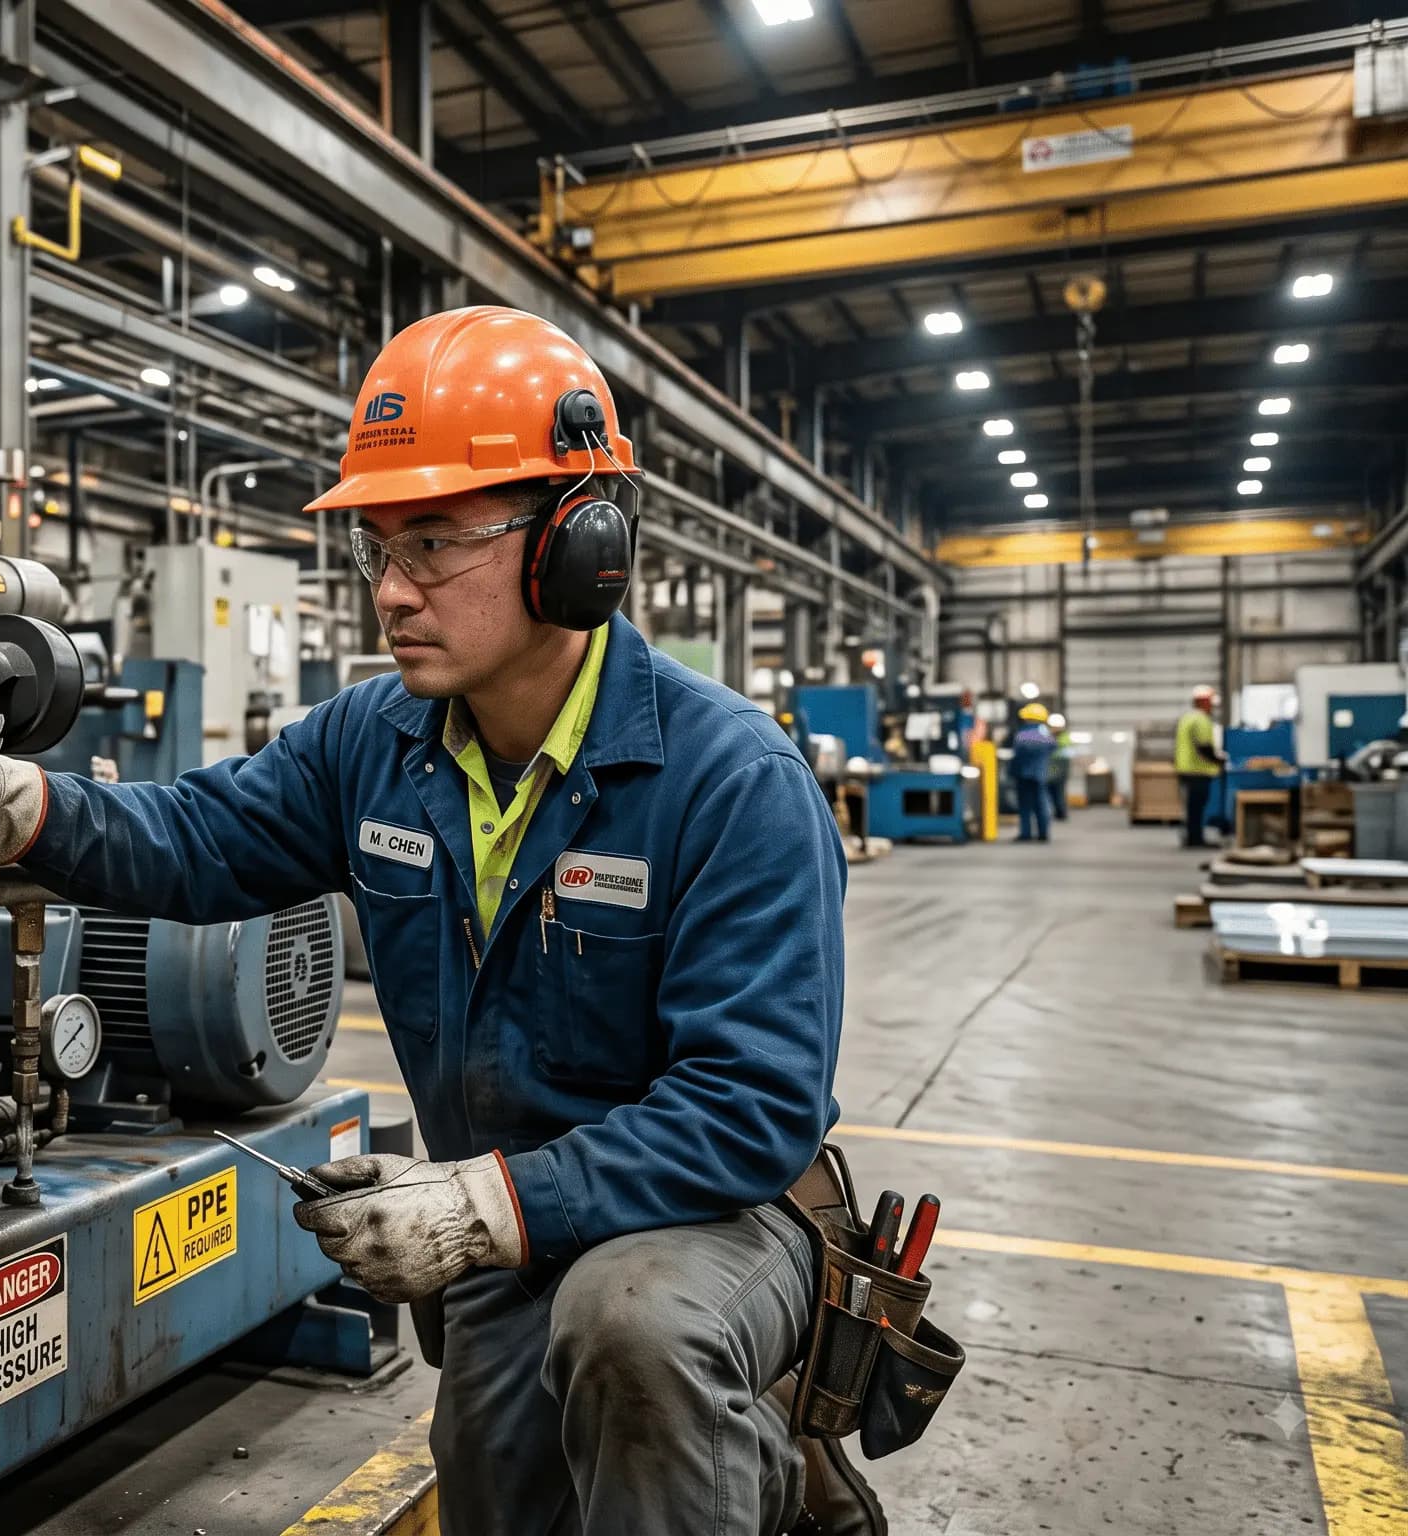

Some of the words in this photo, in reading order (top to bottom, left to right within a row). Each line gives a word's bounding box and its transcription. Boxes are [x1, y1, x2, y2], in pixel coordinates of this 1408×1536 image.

[369, 830, 384, 847] M.
[388, 835, 425, 857] CHEN
[188, 1182, 228, 1231] PPE
[184, 1223, 232, 1264] REQUIRED
